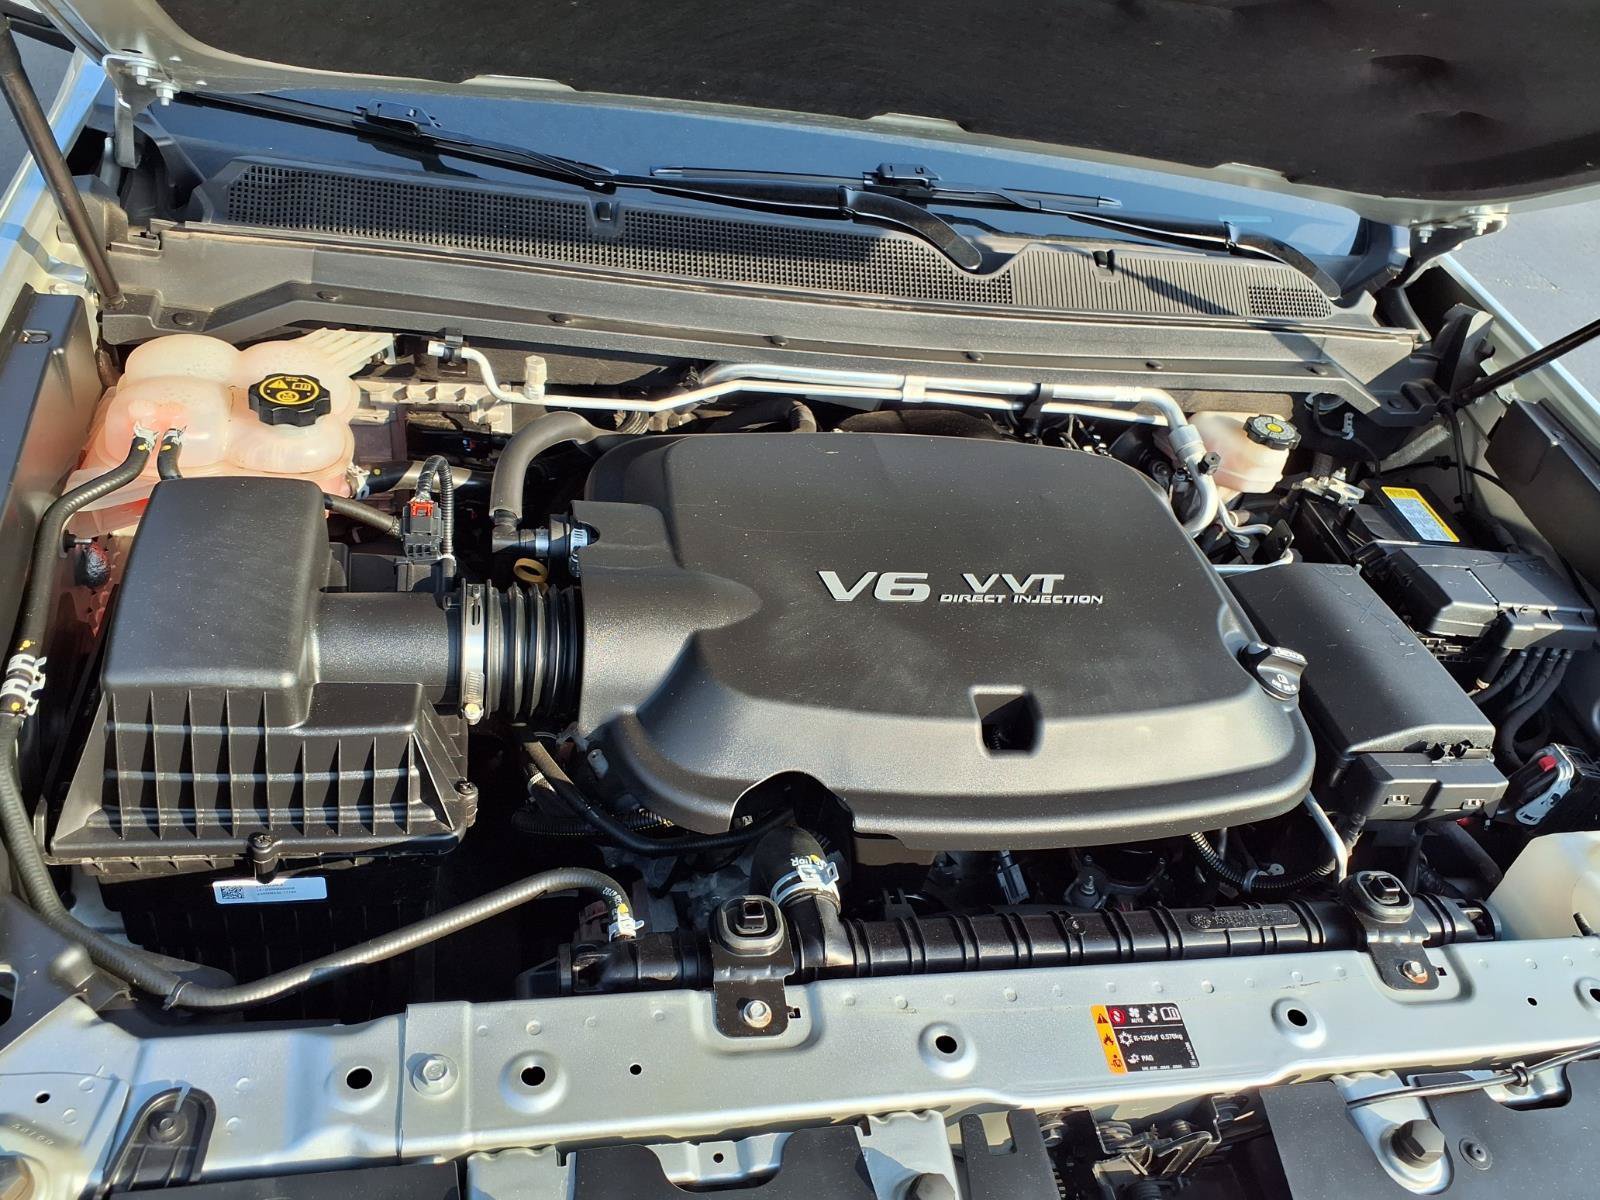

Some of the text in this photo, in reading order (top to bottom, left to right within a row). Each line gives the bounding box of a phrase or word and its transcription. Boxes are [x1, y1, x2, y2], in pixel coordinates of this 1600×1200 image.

[817, 570, 1065, 602] V6 VVT
[940, 594, 1103, 605] DIRECT INJECTION
